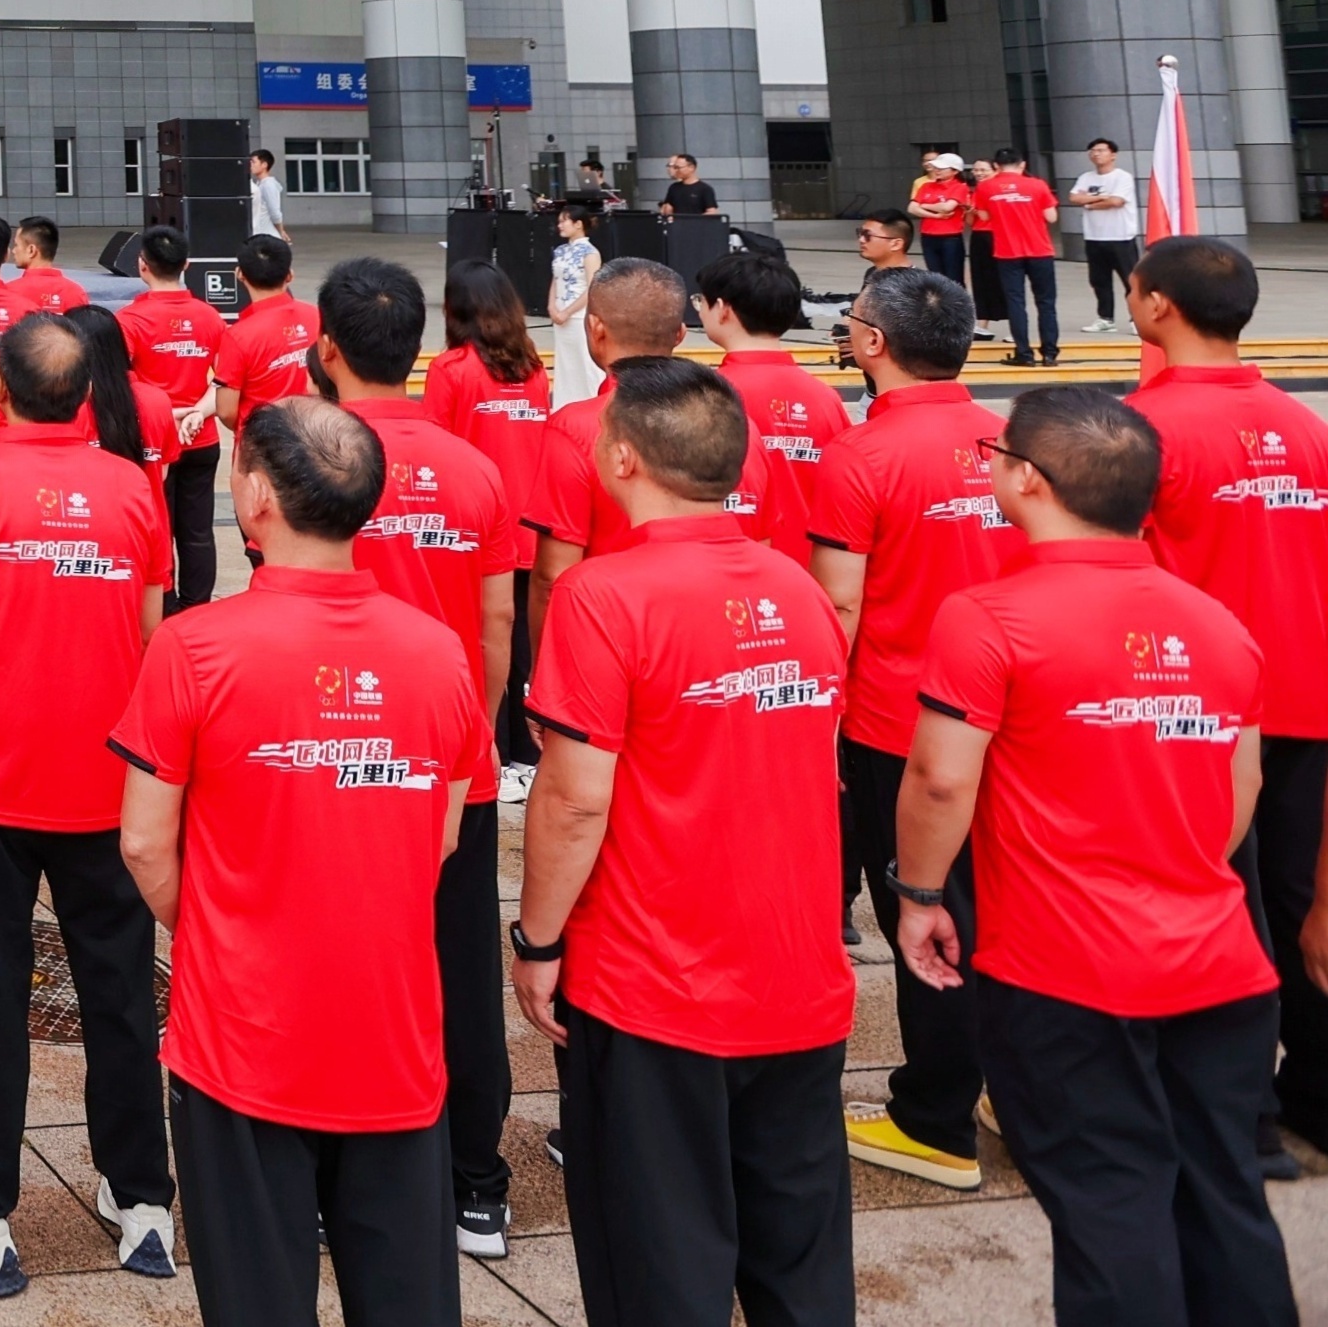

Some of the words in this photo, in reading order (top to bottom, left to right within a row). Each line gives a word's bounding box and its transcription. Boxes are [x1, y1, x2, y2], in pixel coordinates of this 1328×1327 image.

[18, 541, 99, 561] 匠心网络
[53, 558, 113, 578] 万里行
[722, 660, 800, 697] 匠心网络
[756, 679, 819, 713] 万里行
[1111, 695, 1202, 723] 匠心网络
[1156, 715, 1220, 743] 万里行
[292, 737, 393, 767] 匠心网络
[336, 761, 410, 789] 万里行
[463, 1211, 491, 1221] ERKE
